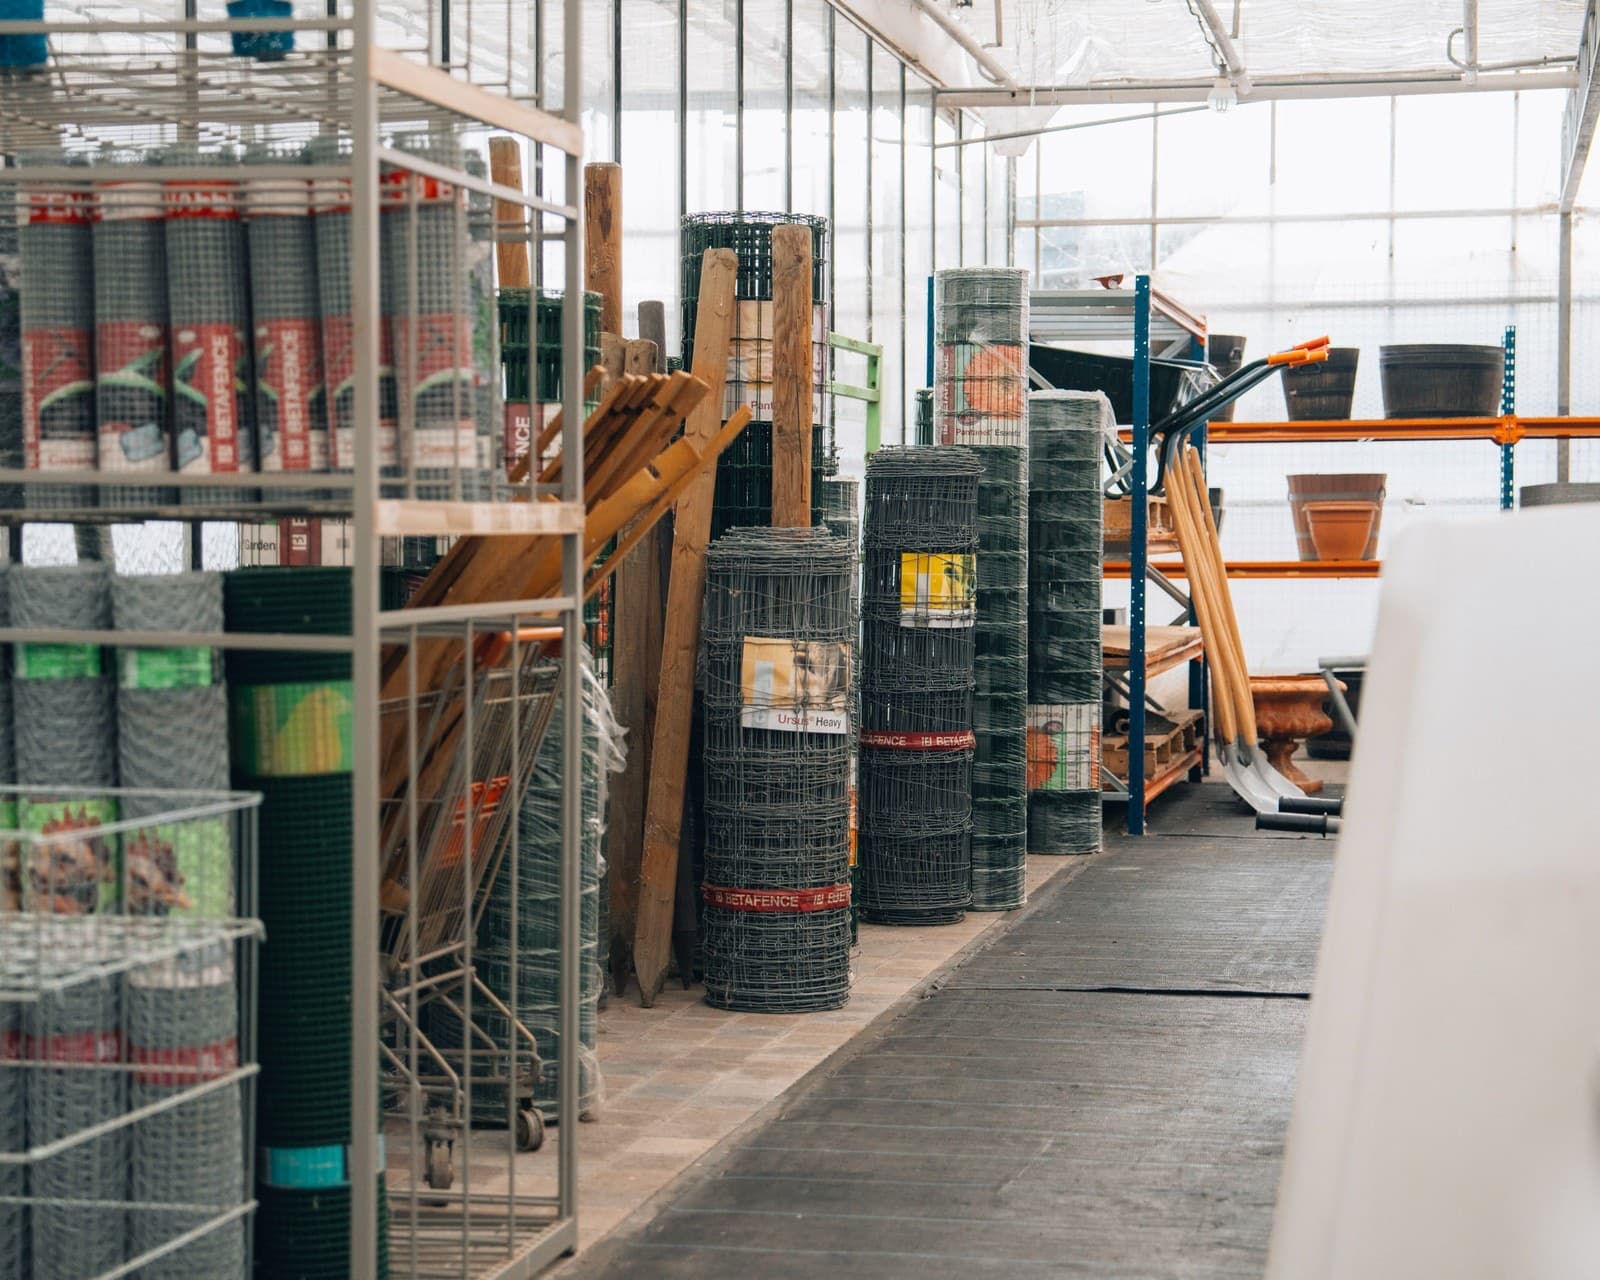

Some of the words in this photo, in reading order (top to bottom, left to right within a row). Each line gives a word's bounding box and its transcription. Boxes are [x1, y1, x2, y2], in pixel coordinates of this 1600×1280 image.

[211, 335, 233, 438] BETAFENCE
[815, 716, 842, 729] Heavy
[725, 893, 799, 908] BETAFENCE
